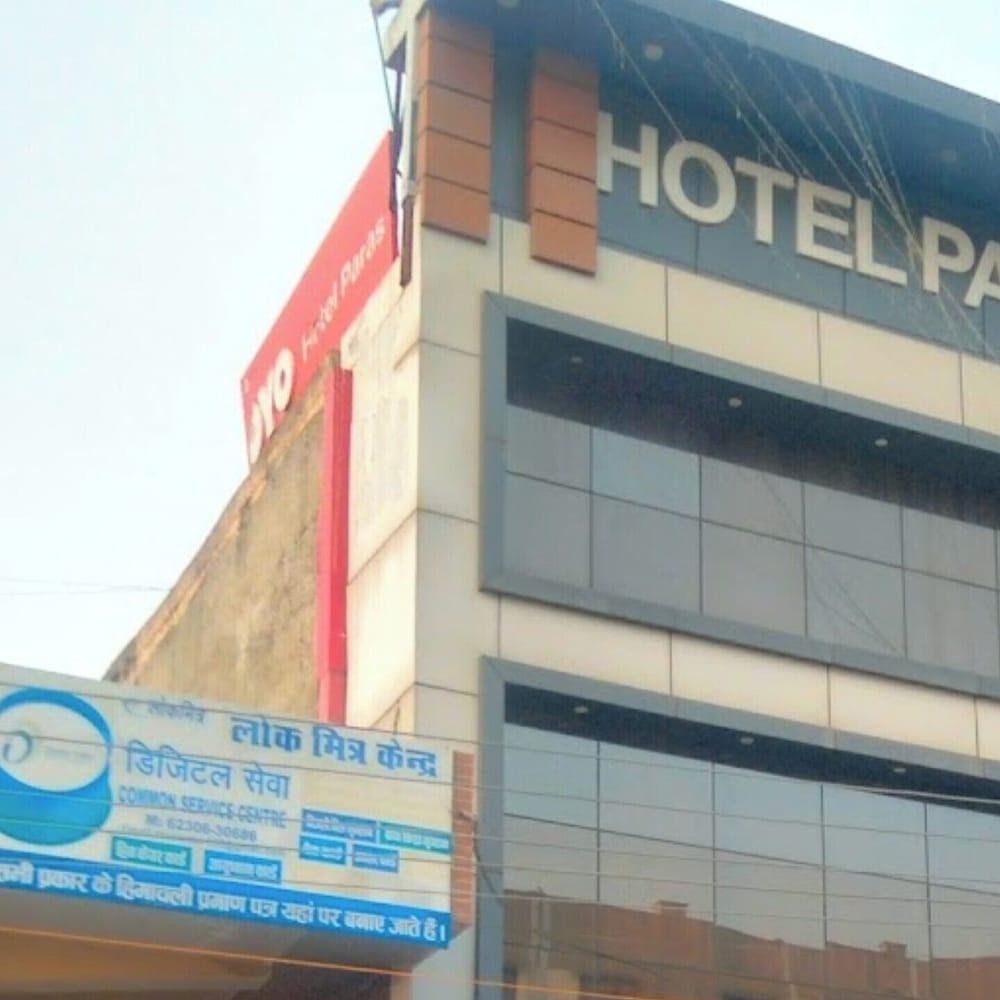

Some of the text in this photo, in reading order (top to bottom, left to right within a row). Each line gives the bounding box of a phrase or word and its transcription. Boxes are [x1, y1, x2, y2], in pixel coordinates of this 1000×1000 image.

[597, 112, 907, 286] HOTEL
[341, 215, 385, 296] Paras
[127, 739, 291, 800] डिजिटल सेवा
[231, 715, 438, 777] लोक मित्र केन्द्र
[119, 784, 177, 807] COMMON
